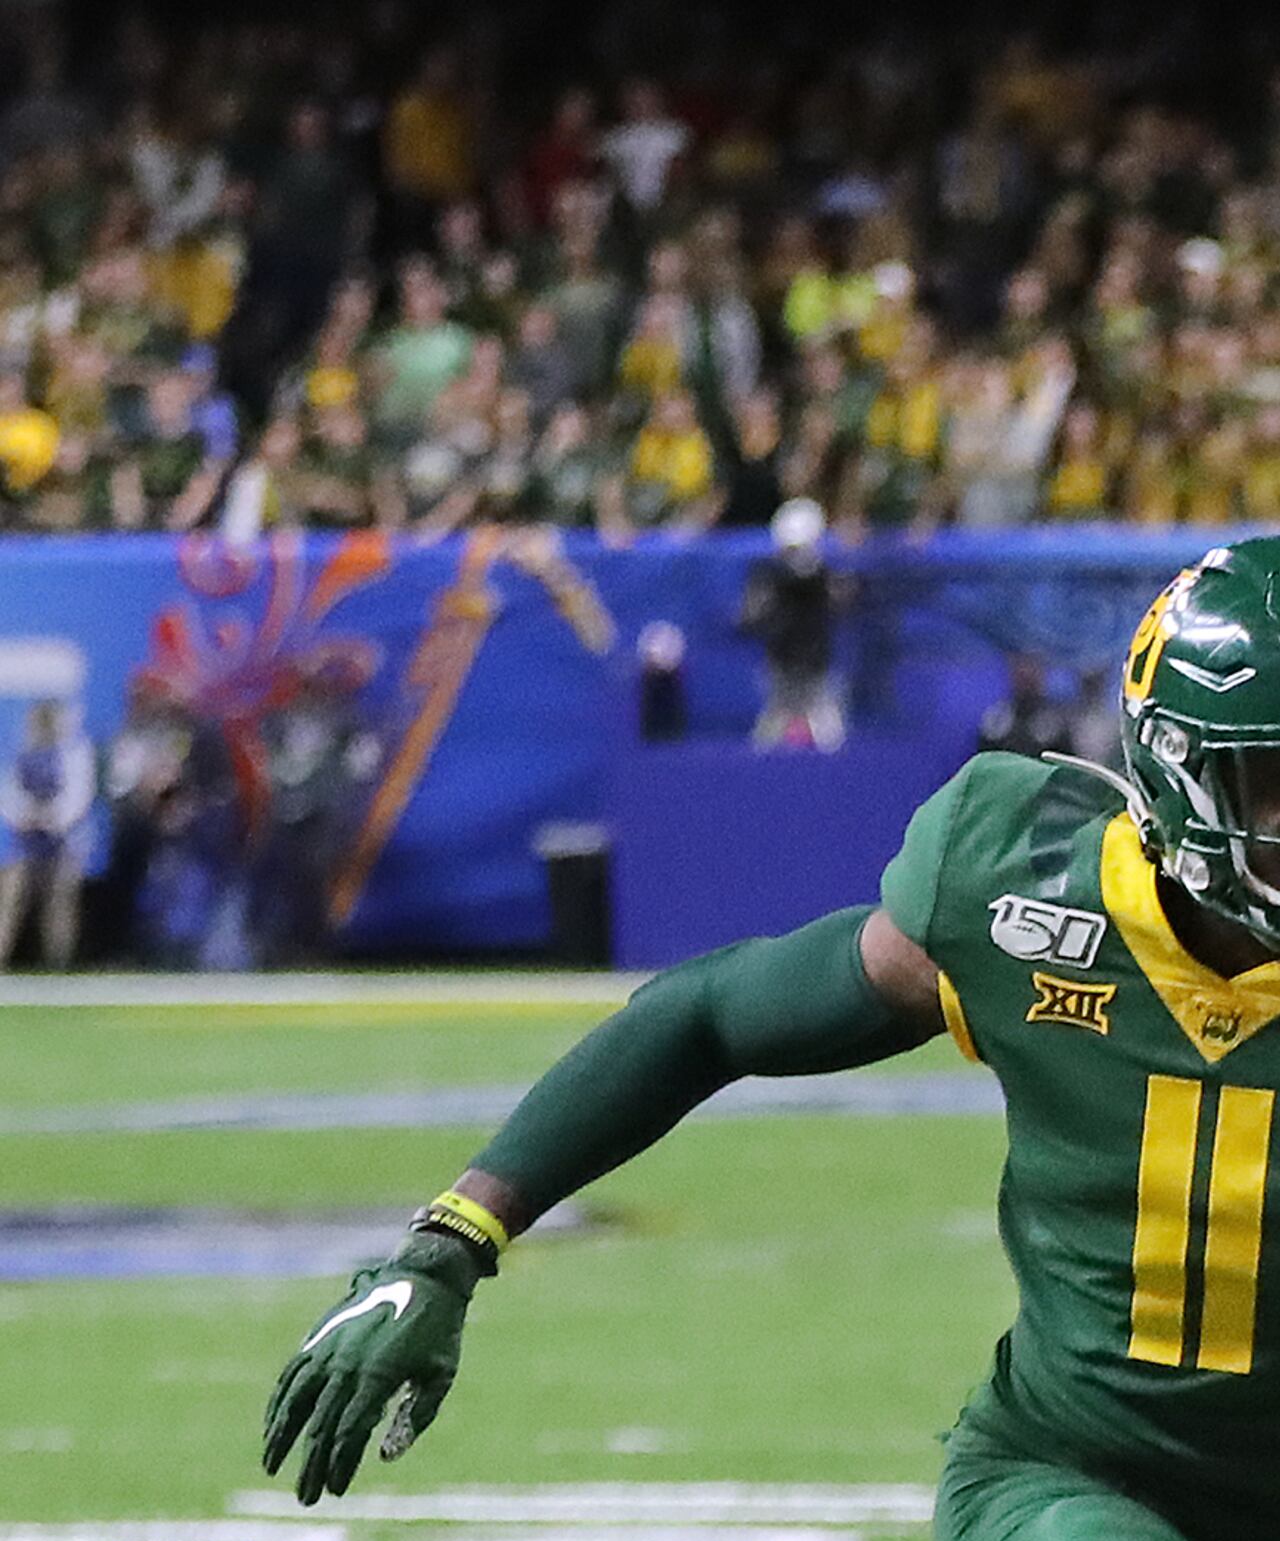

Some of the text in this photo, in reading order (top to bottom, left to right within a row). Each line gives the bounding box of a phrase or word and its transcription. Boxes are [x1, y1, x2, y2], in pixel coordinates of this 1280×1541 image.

[988, 894, 1107, 969] 150
[1030, 976, 1113, 1031] XII
[1128, 1074, 1275, 1374] 11
